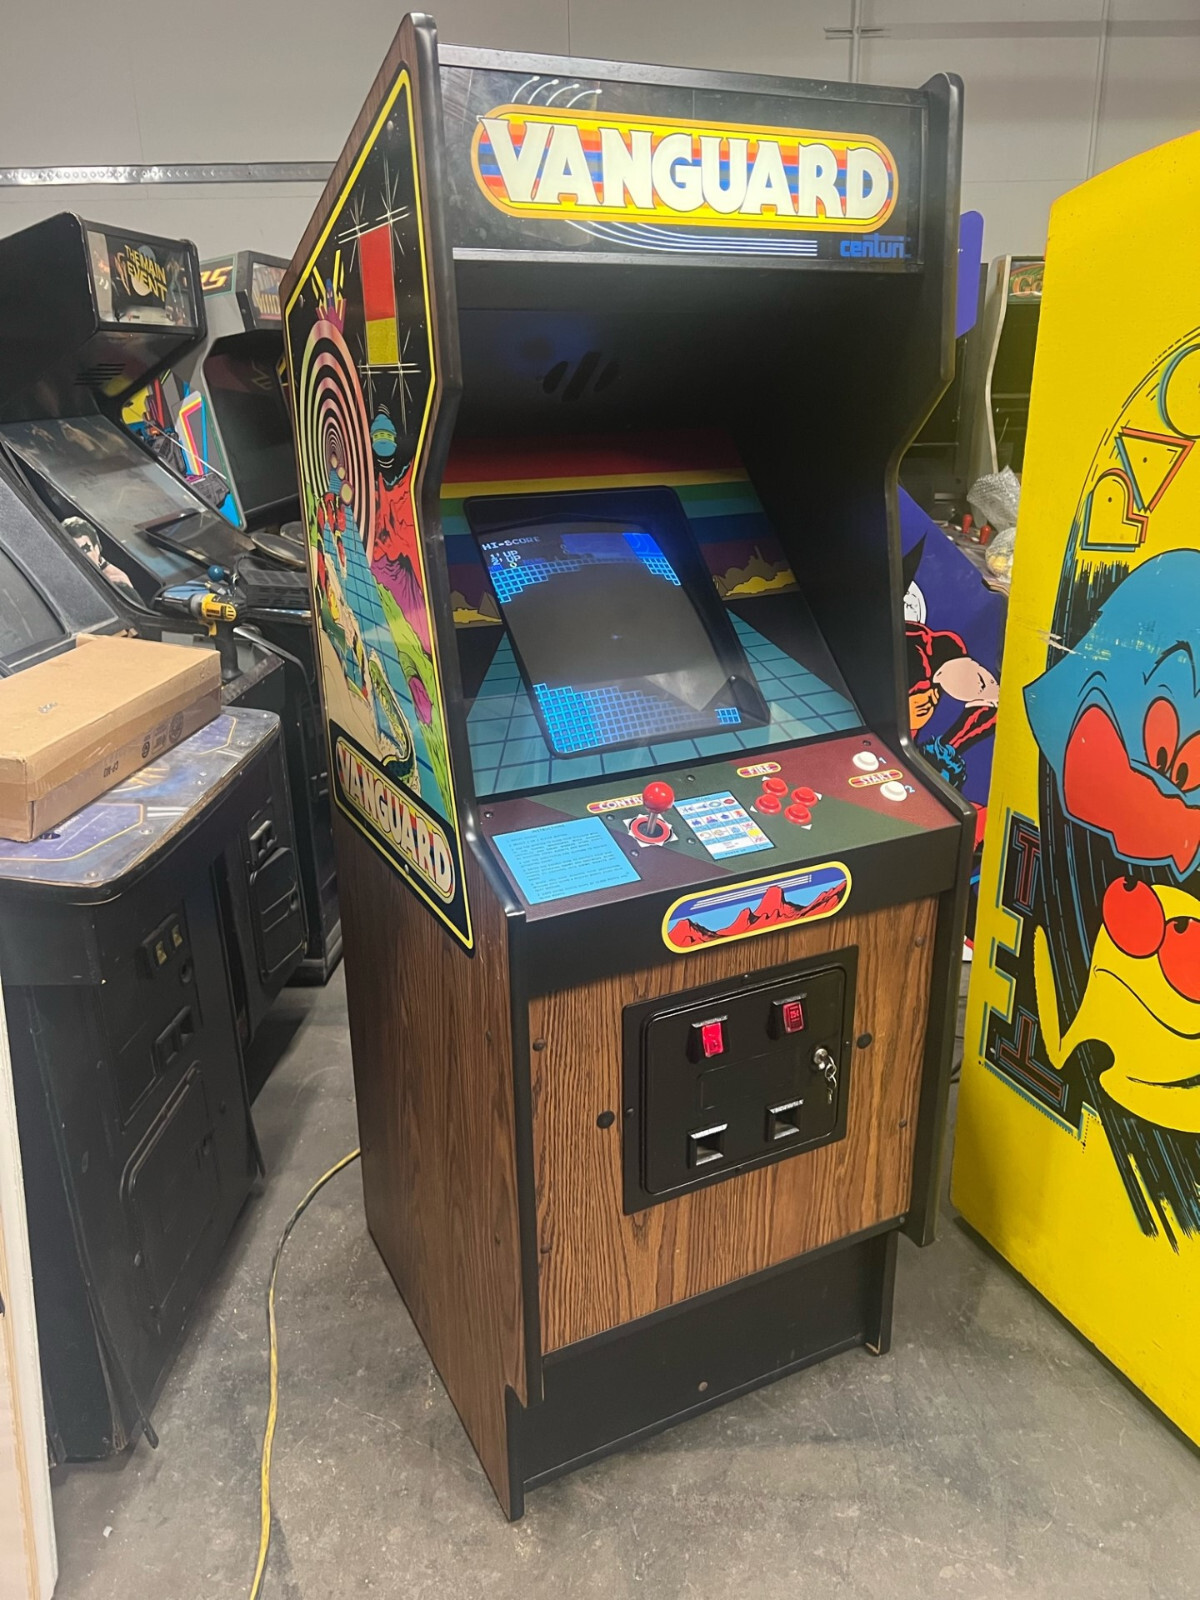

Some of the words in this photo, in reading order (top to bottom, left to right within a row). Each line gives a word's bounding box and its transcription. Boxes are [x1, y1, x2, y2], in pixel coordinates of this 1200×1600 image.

[480, 117, 890, 219] VANGUARD
[124, 244, 141, 267] THE
[140, 254, 167, 285] MAIN
[126, 261, 168, 302] EVENT
[748, 765, 773, 776] FIRE
[861, 772, 893, 784] START
[905, 785, 915, 793] 2
[337, 742, 452, 894] VANGUARD
